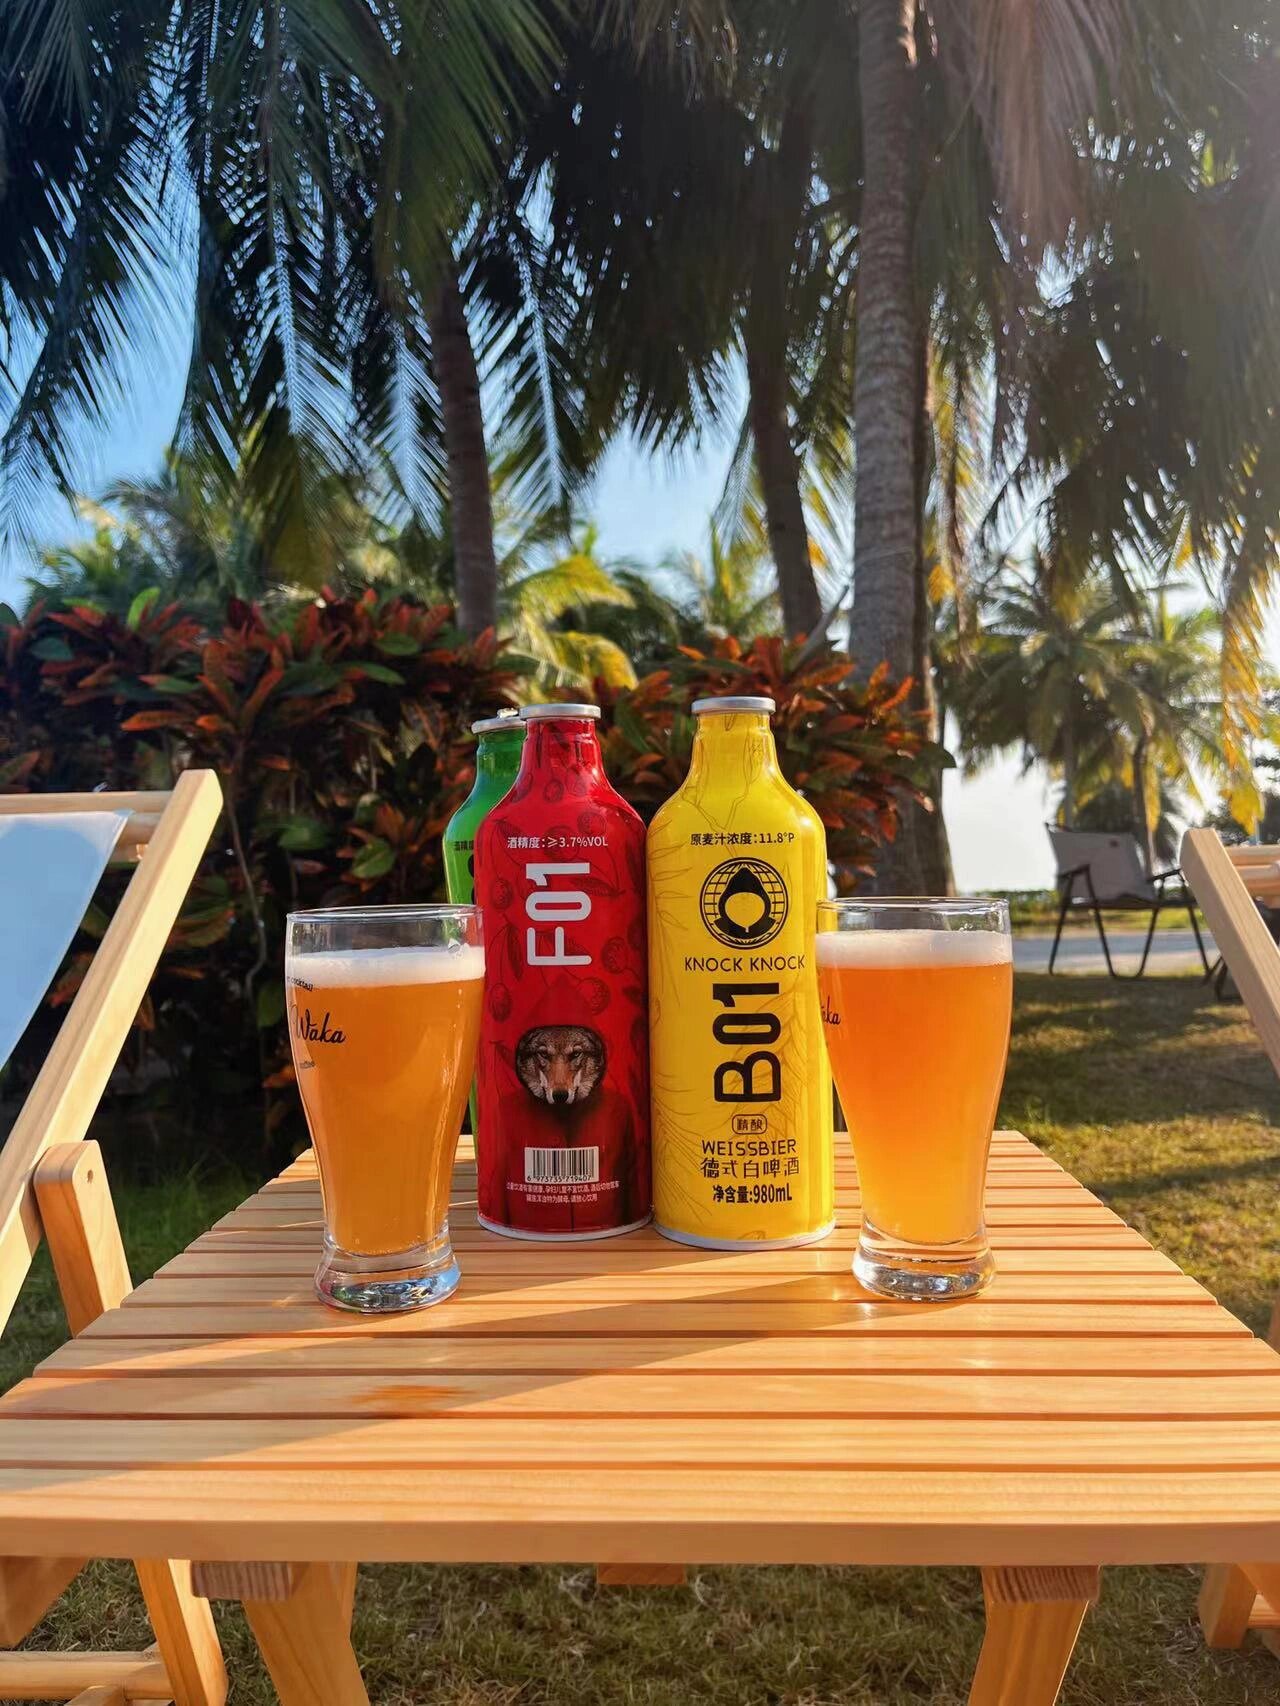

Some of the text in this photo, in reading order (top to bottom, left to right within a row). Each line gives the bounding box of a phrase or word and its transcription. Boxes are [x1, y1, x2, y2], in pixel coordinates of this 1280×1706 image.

[526, 862, 592, 967] F01
[684, 956, 806, 972] KNOCK KNOCK
[713, 983, 781, 1103] B01
[702, 1139, 797, 1156] WEISSBIER
[700, 1157, 800, 1179] 德式白啤酒
[712, 1183, 793, 1204] 净含量:980mL
